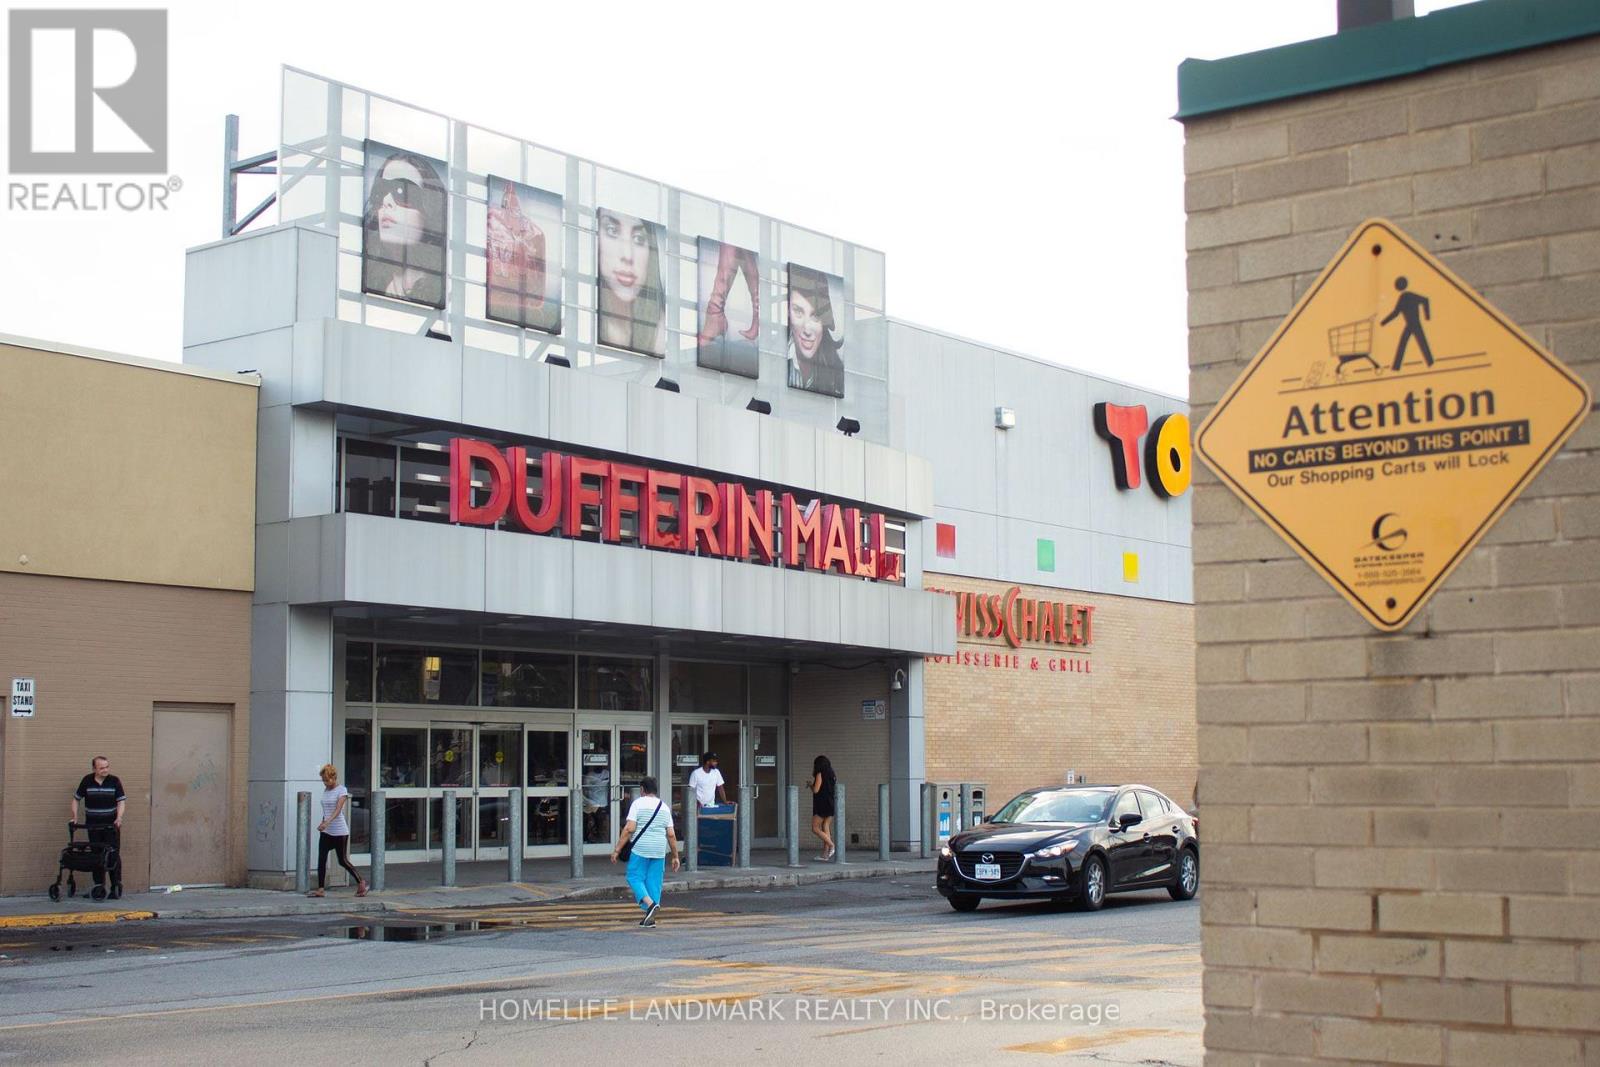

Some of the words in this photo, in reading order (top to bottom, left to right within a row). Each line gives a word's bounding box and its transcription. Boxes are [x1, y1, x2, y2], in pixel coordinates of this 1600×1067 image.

[1282, 388, 1495, 438] Attention
[1254, 452, 1278, 468] NO
[1283, 445, 1335, 465] CARTS
[1342, 438, 1409, 460] BEYOND
[1415, 432, 1453, 452] THIS
[1460, 424, 1512, 446] POINT
[1267, 474, 1295, 487] Our
[1300, 463, 1374, 484] Shopping
[1382, 459, 1426, 476] Carts
[1434, 455, 1460, 471] will
[1468, 450, 1509, 468] Lock
[449, 437, 773, 565] DUFFERIN
[782, 492, 900, 581] MALL
[1030, 656, 1040, 671] &
[1049, 658, 1092, 674] GRILL
[13, 695, 33, 706] STAND
[16, 681, 31, 692] TAXI
